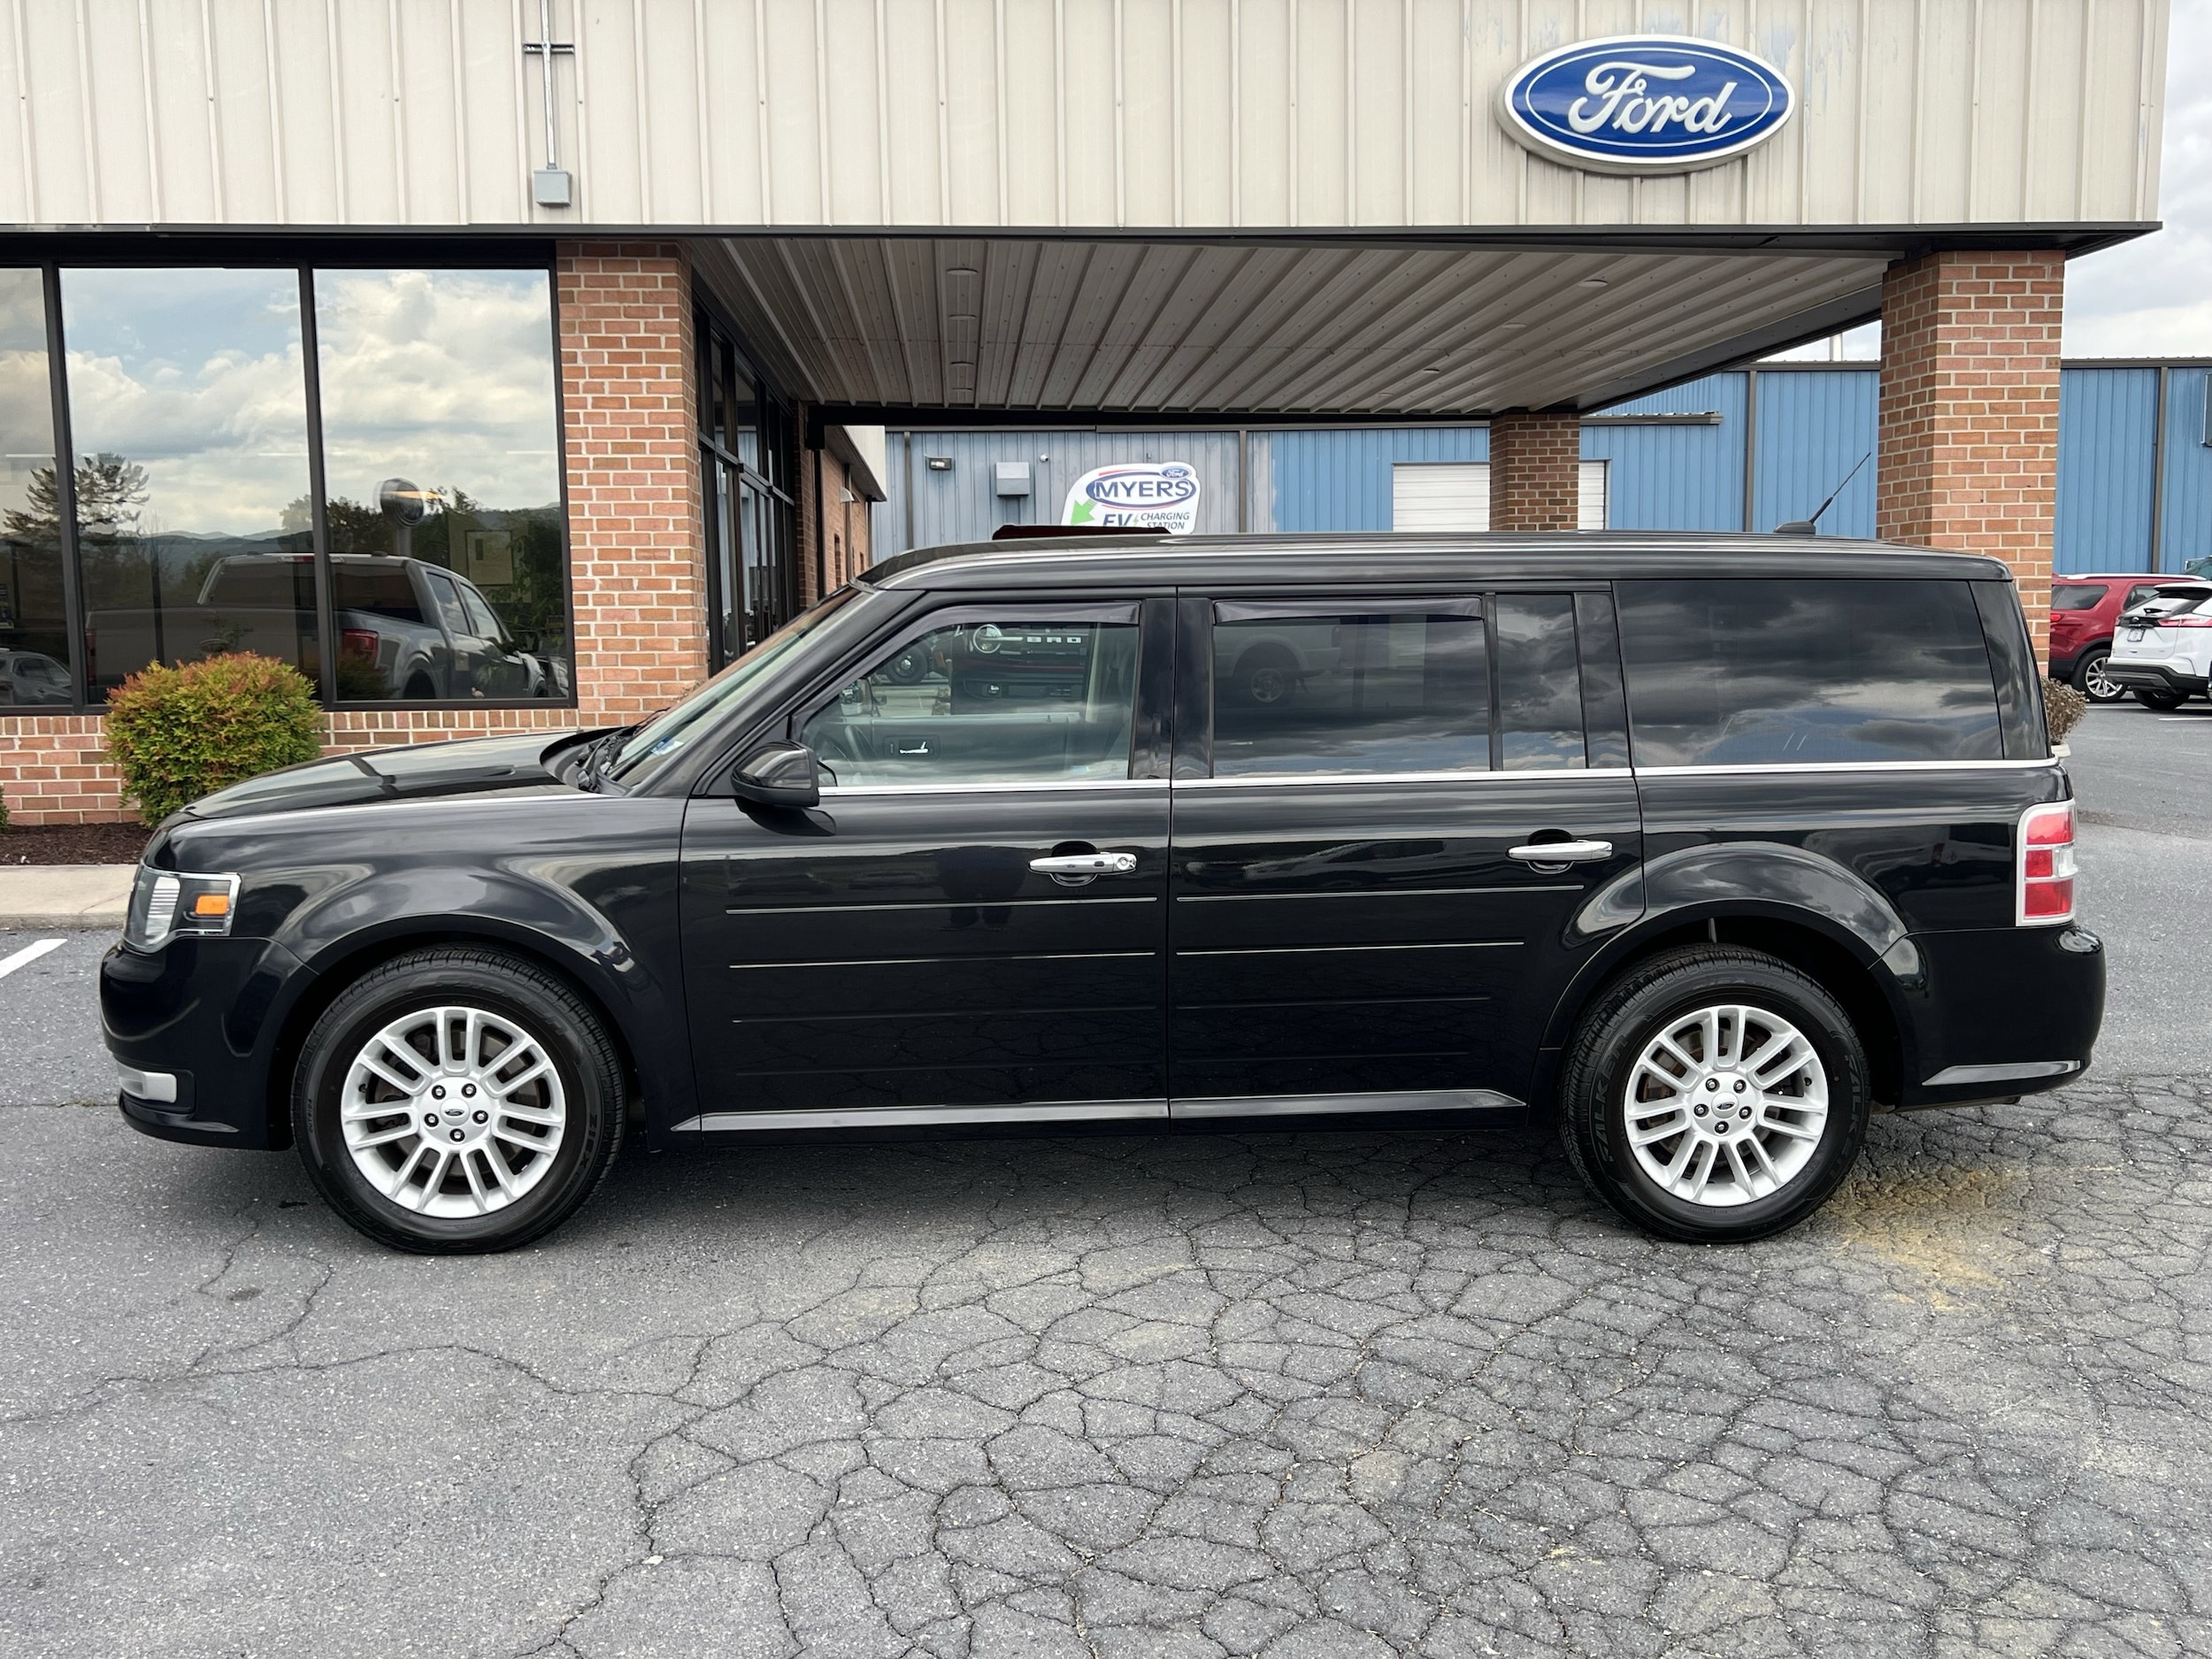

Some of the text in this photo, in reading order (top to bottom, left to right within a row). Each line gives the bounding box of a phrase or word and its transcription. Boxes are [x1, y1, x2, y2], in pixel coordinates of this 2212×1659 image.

[1568, 61, 1738, 134] Ford
[1095, 481, 1190, 497] MYERS
[1141, 512, 1190, 521] CHARGING
